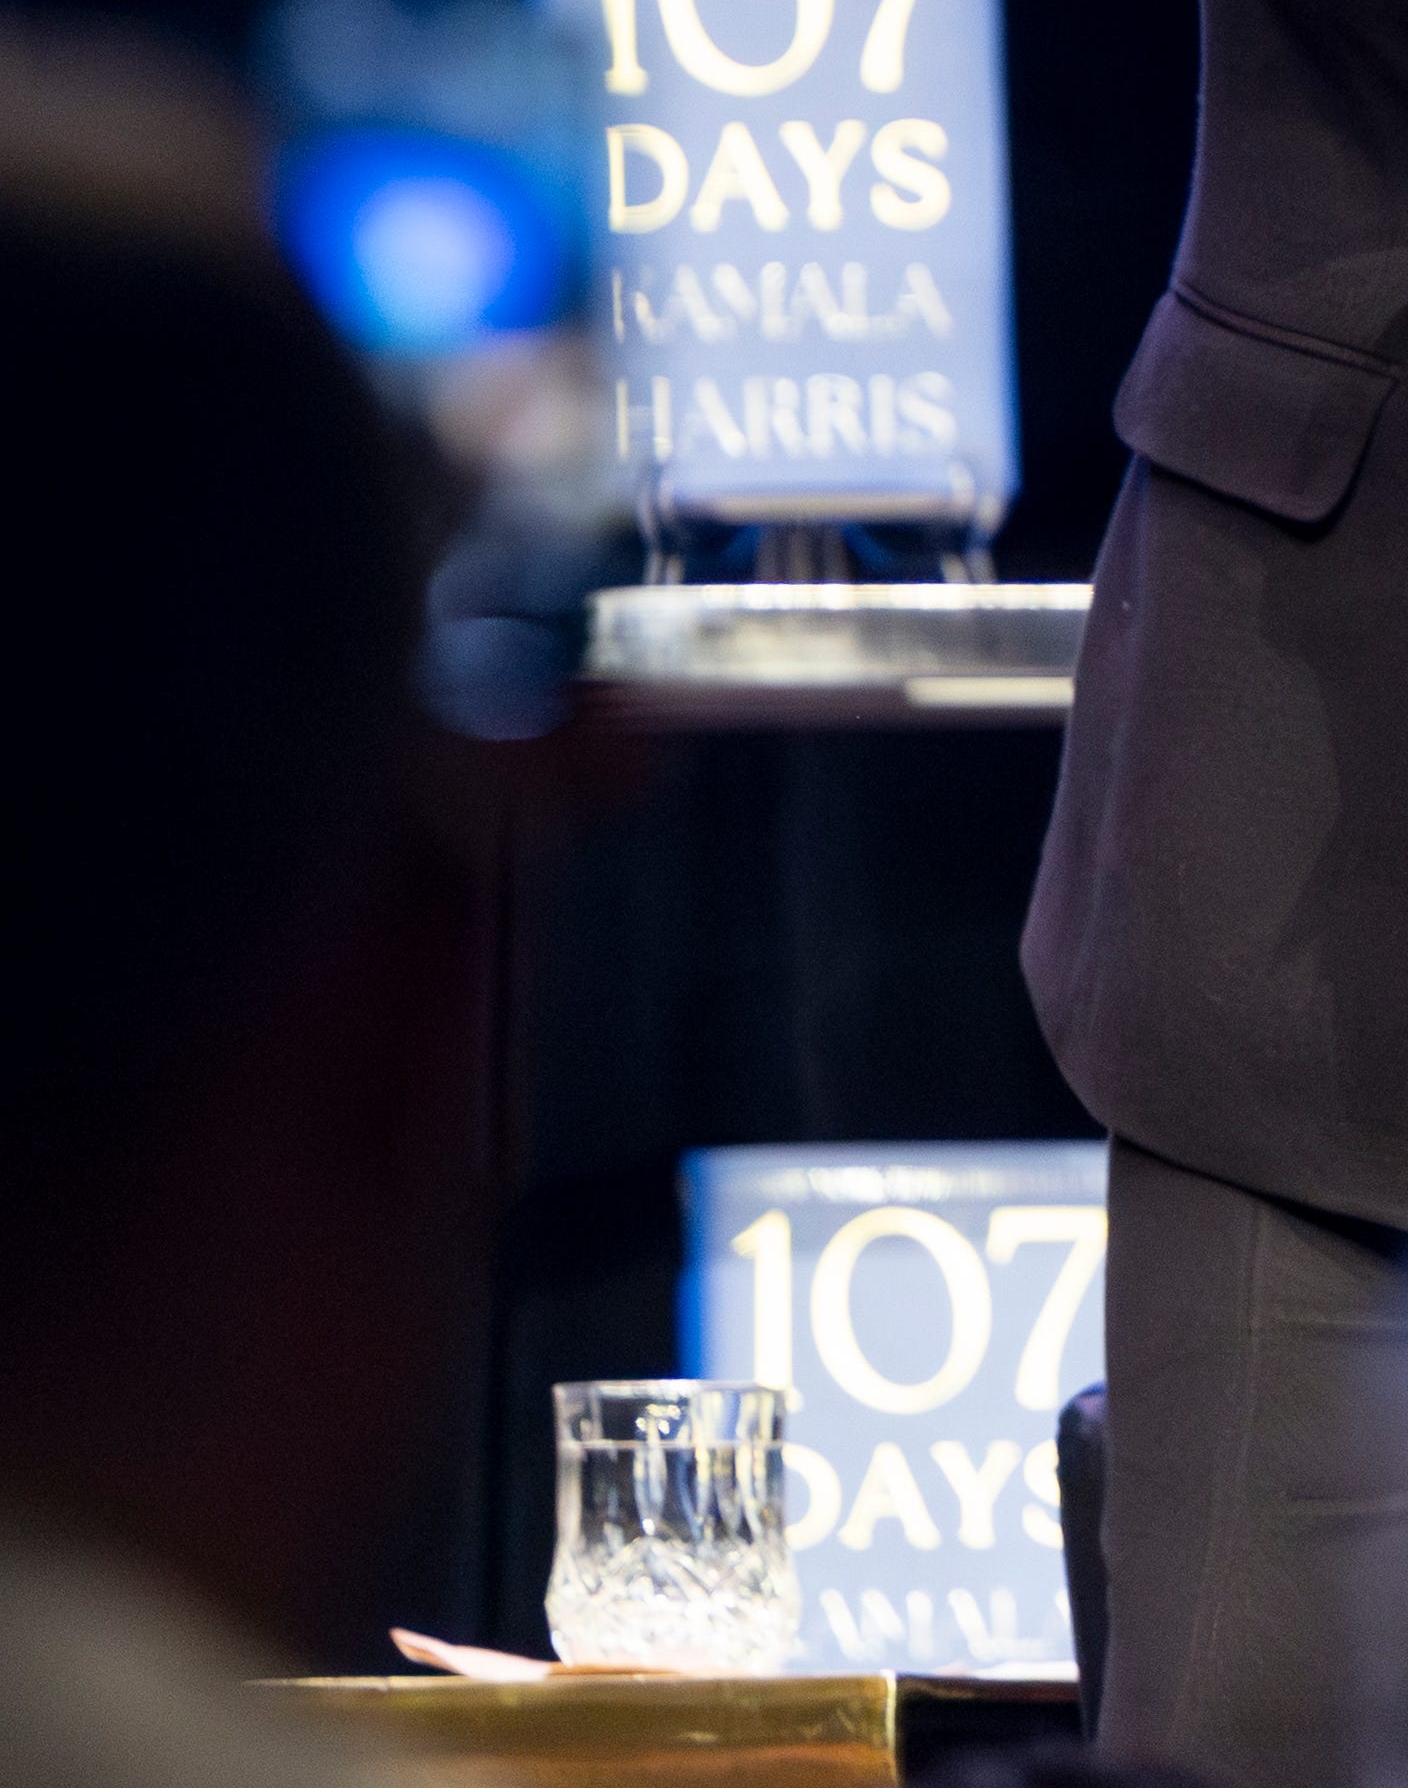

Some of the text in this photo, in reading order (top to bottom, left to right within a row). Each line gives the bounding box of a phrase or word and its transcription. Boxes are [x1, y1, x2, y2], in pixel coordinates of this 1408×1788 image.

[606, 117, 953, 235] DAYS
[615, 370, 958, 460] HARRIS
[731, 1205, 1108, 1415] 107
